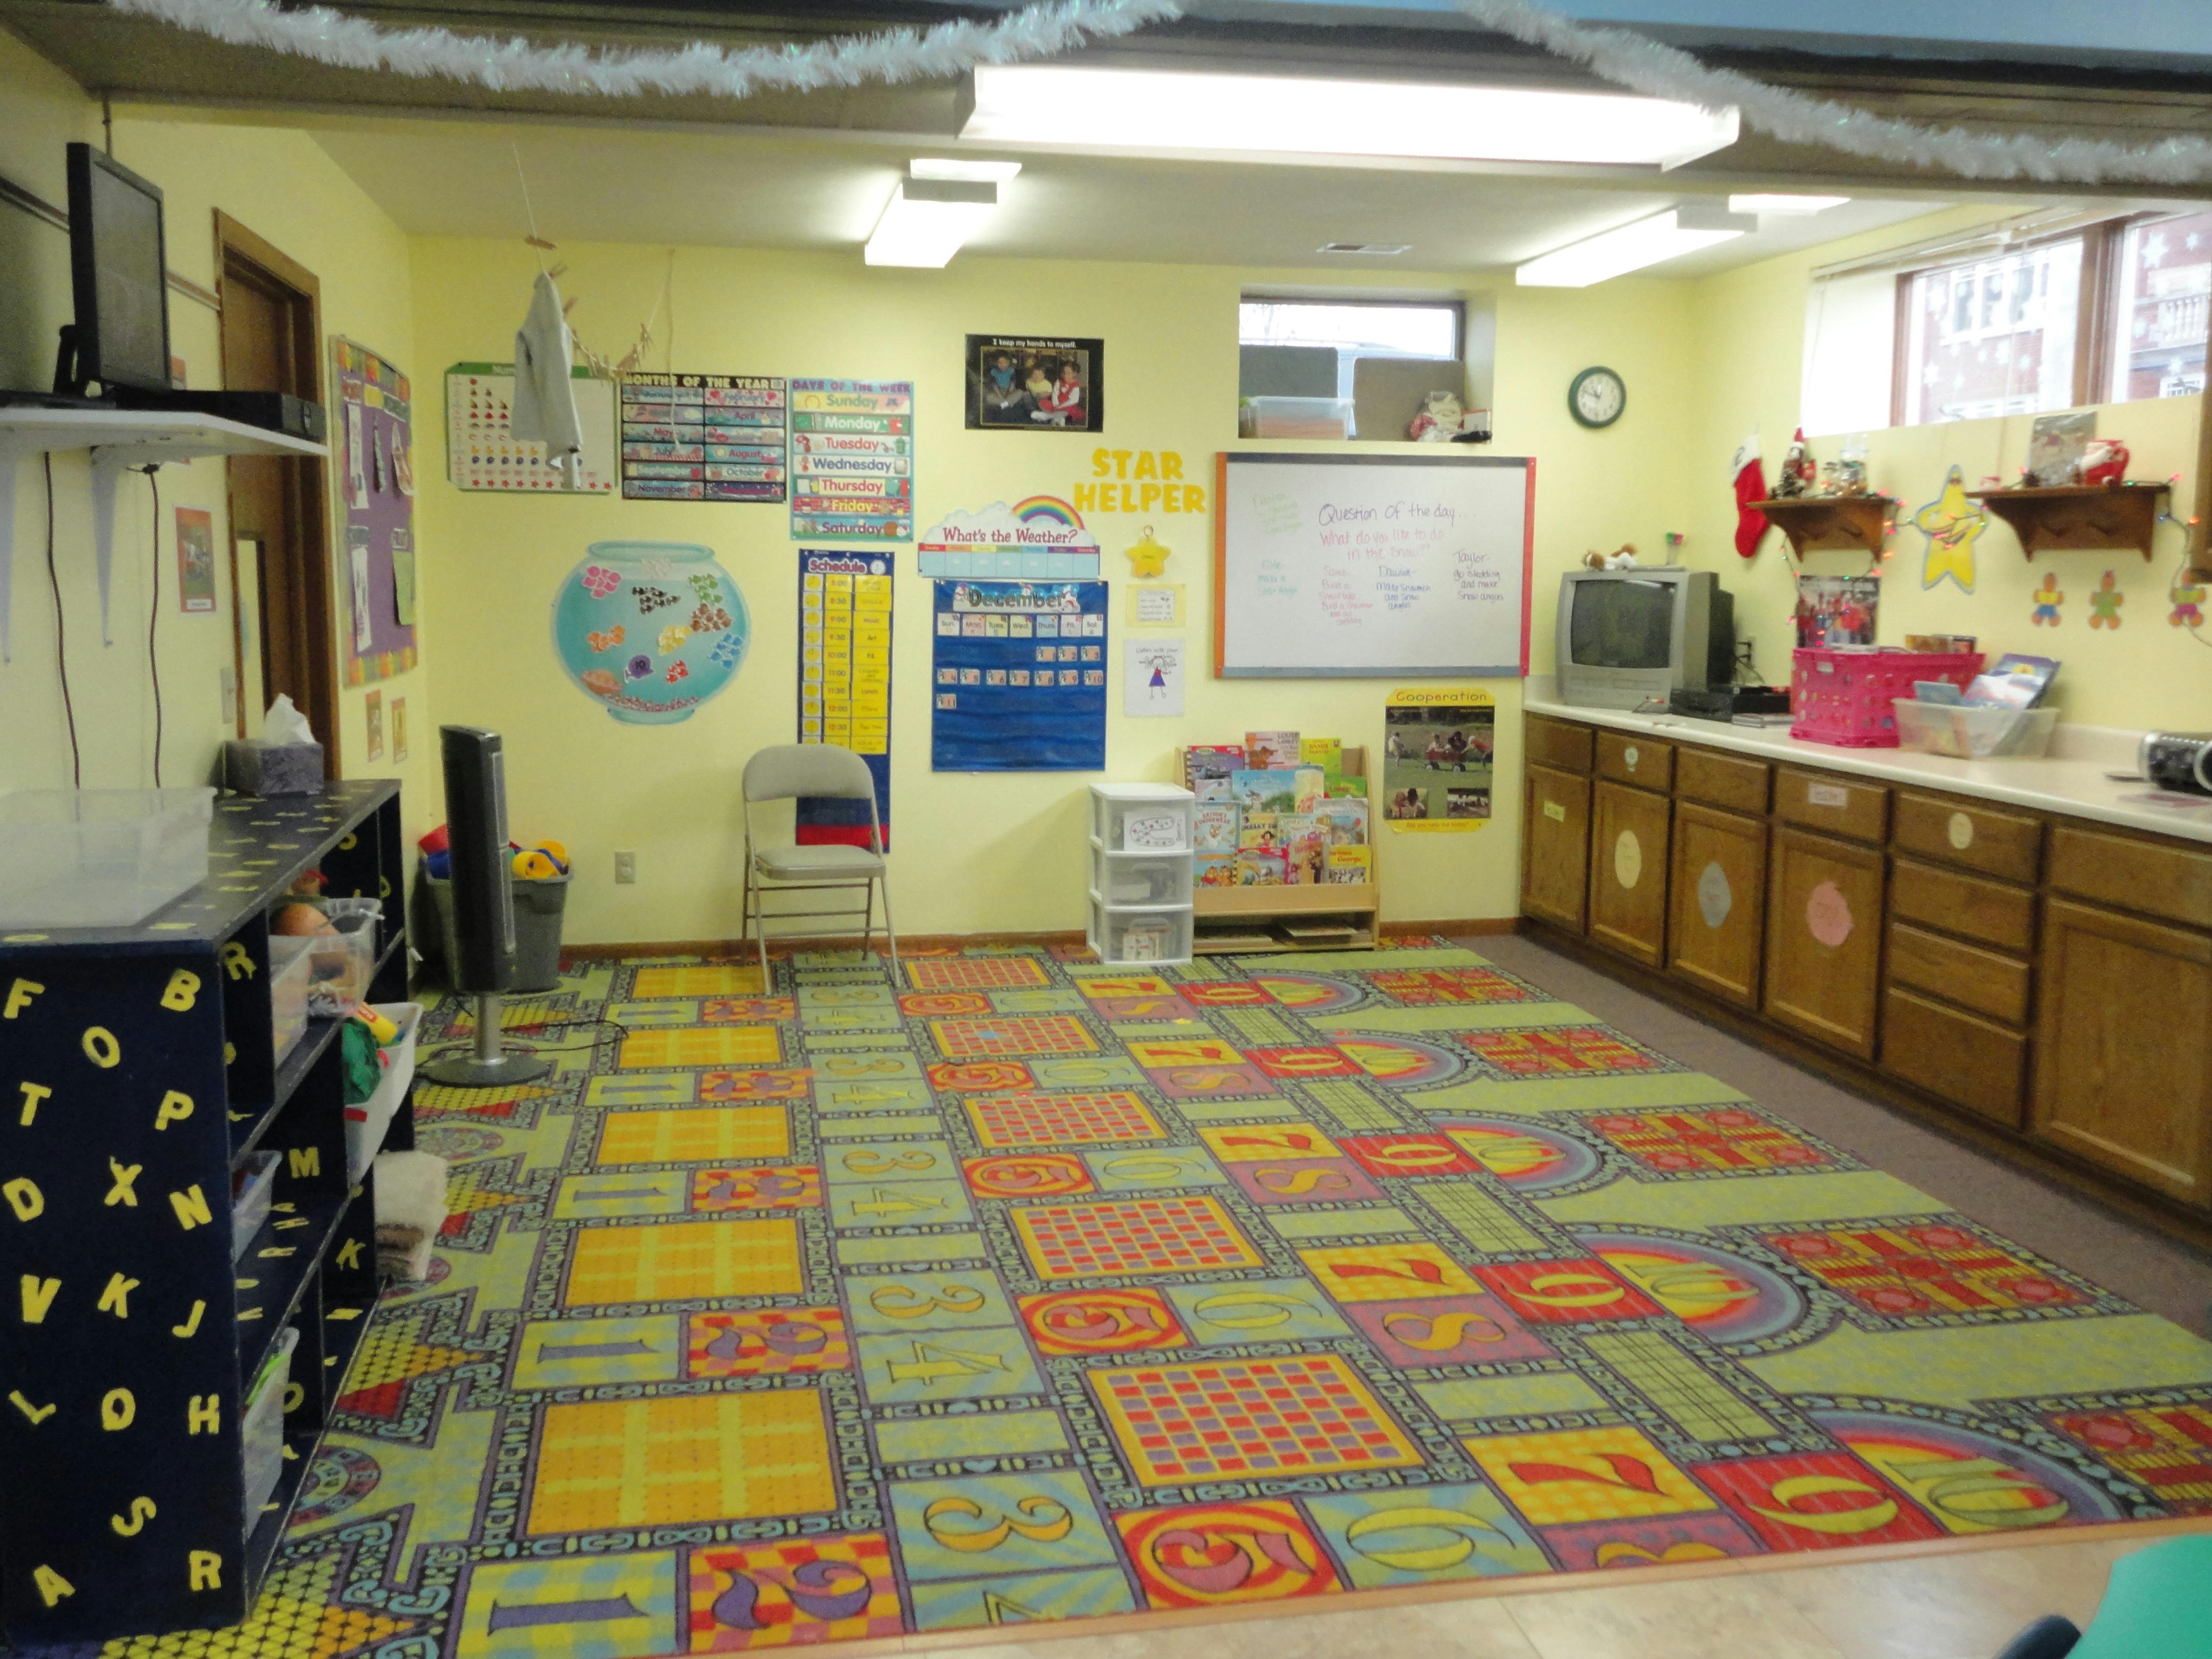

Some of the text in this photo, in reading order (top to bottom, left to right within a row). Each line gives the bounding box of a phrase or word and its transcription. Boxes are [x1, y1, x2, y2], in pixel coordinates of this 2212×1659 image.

[999, 338, 1014, 347] keep
[626, 375, 769, 389] MONTHS OF THE YEAR
[792, 380, 910, 393] DAYS OF THE WEEK
[826, 394, 877, 409] Sunday
[825, 416, 881, 432] Monday
[729, 450, 761, 460] August
[825, 437, 879, 453] Tuesday
[727, 466, 765, 477] October
[813, 457, 891, 473] Wednesday
[1091, 448, 1184, 480] STAR
[639, 485, 685, 494] November
[822, 478, 883, 493] Thursday
[832, 499, 873, 513] Friday
[1074, 483, 1206, 513] HELPER
[1319, 504, 1377, 526] Question
[1409, 503, 1430, 517] the
[822, 522, 883, 537] Saturday
[943, 526, 1078, 543] What's the Weather?
[809, 558, 866, 573] Schedule
[969, 589, 1066, 608] December
[1396, 691, 1486, 704] Cooperation
[3, 977, 45, 1019] F
[159, 969, 201, 1012] B
[82, 1026, 120, 1068] O
[20, 1081, 52, 1126] T
[155, 1090, 194, 1131] P
[289, 1147, 320, 1178] M
[104, 1155, 142, 1207] X
[169, 1184, 213, 1230] N
[97, 1272, 140, 1318] K
[172, 1300, 206, 1338] J
[188, 1393, 220, 1435] H
[111, 1496, 157, 1537] S
[188, 1550, 222, 1591] R
[33, 1564, 76, 1607] A
